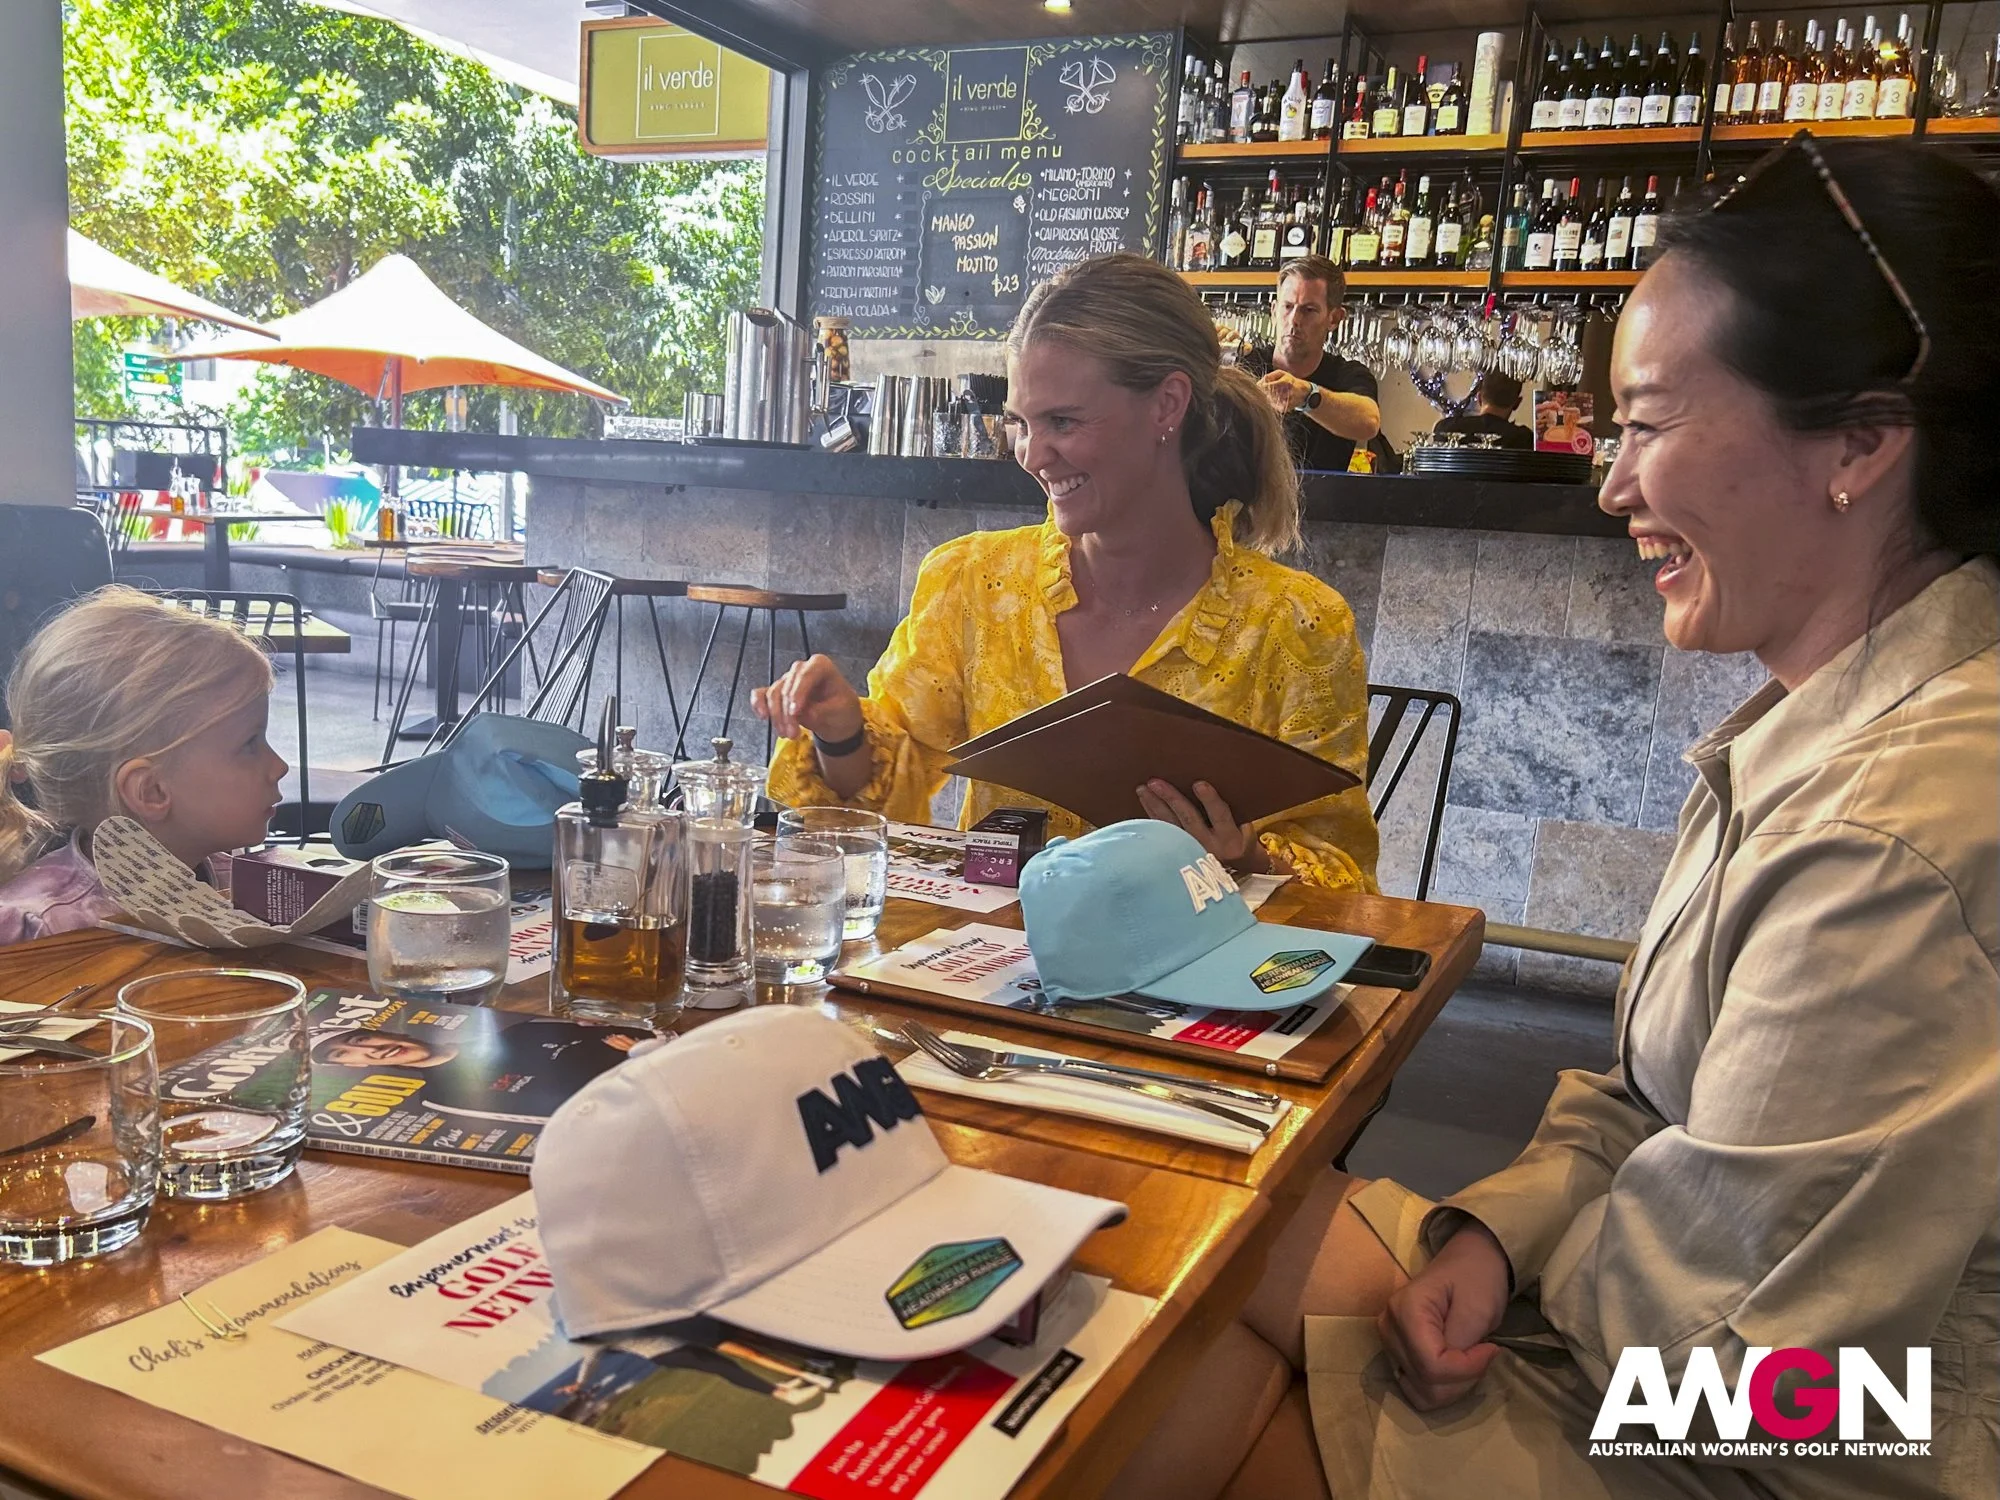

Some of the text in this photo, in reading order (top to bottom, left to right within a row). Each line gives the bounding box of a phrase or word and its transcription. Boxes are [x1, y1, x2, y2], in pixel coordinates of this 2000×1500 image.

[644, 60, 714, 91] il verde
[952, 74, 1017, 101] il verde
[1890, 91, 1900, 104] 3
[1796, 95, 1806, 108] 3
[1824, 95, 1834, 108] 3
[1855, 92, 1865, 105] 3
[892, 144, 1063, 164] cocktail menu
[845, 172, 879, 187] VERDE
[922, 158, 1032, 196] Specials
[830, 192, 875, 206] ROSSINI
[1042, 187, 1101, 202] NEGRONI
[829, 211, 875, 224] BELLINI
[931, 213, 975, 232] MANGO
[1040, 208, 1058, 222] OLD
[1058, 207, 1093, 222] FASHION
[829, 229, 899, 243] APEROL SPRITZ
[952, 225, 998, 251] PASSION
[1039, 227, 1089, 241] CAIPIROSKA
[827, 249, 873, 261] ESPRESSO
[1089, 241, 1117, 254] FRUIT
[956, 255, 998, 273] MOJITO
[825, 286, 892, 299] FRENCH MARTINI
[991, 273, 1020, 298] $23
[855, 304, 890, 317] COLADA
[927, 953, 976, 974] GOLF
[1257, 953, 1326, 983] PERFORMANCE
[1260, 966, 1302, 988] HEADWEAR
[1302, 957, 1329, 971] RANGE
[361, 1000, 408, 1032] Women
[325, 1075, 427, 1117] GOLD
[311, 1113, 372, 1136] &
[389, 1225, 523, 1299] Empowerment
[437, 1242, 541, 1300] GOLF
[896, 1243, 1009, 1308] PERFORMANCE
[902, 1273, 971, 1318] HEADWEAR
[970, 1252, 1015, 1279] RANGE
[827, 1439, 865, 1475] Join the
[846, 1436, 891, 1481] Australian
[866, 1474, 883, 1488] to
[906, 1426, 925, 1446] your
[889, 1473, 910, 1494] and
[906, 1455, 925, 1476] your
